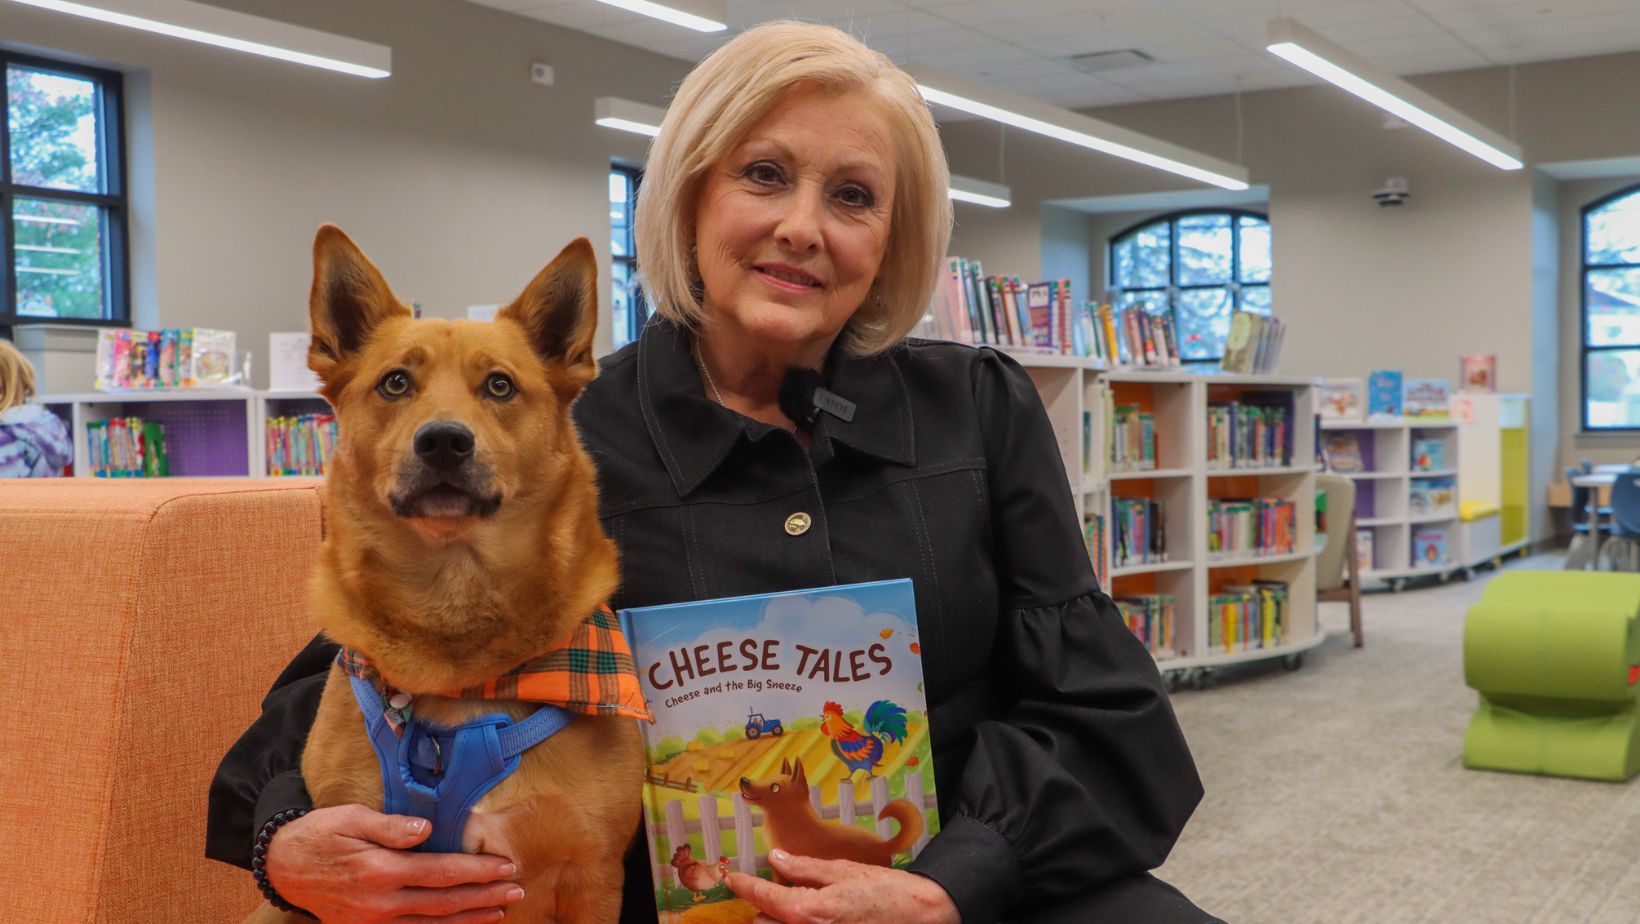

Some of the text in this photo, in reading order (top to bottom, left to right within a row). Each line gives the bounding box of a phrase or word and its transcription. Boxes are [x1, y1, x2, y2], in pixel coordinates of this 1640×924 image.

[648, 638, 893, 690] CHEESE TALES
[665, 679, 803, 708] Cheese and the Big Sneeze
